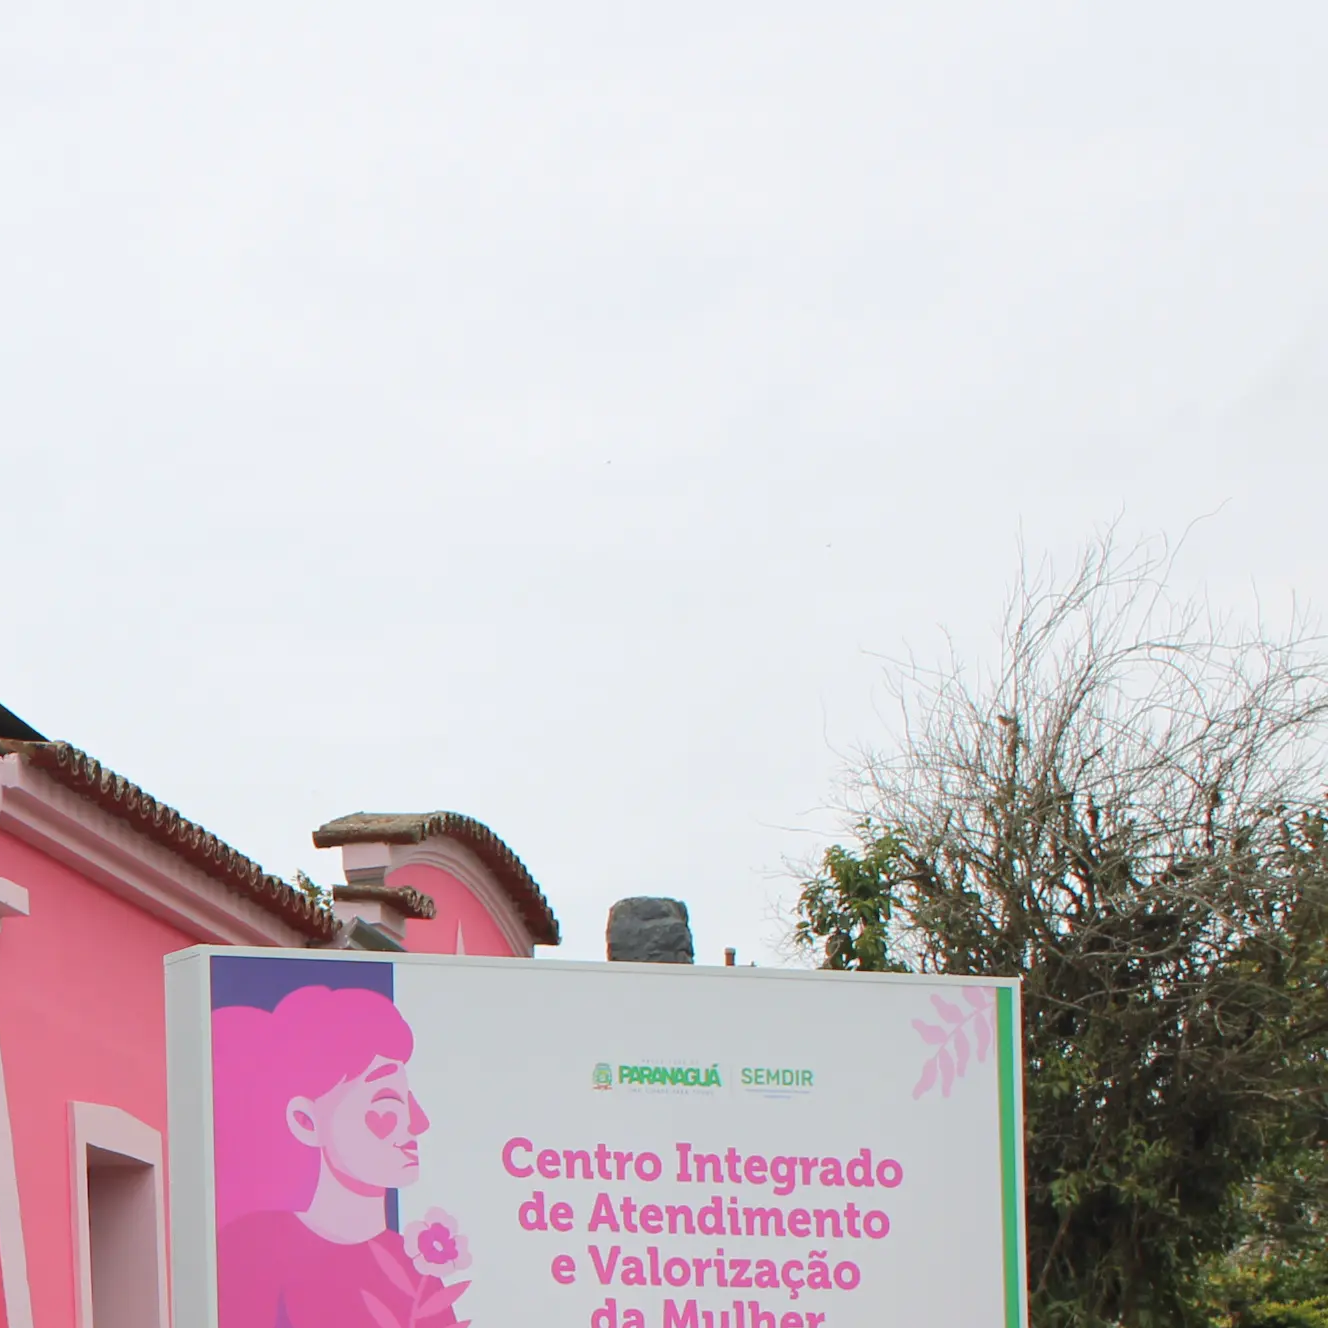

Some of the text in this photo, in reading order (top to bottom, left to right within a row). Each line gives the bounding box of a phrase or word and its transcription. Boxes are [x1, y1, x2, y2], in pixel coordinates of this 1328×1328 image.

[618, 1063, 722, 1087] PARANAGUÁ
[741, 1068, 814, 1087] SEMDIR
[501, 1136, 904, 1196] Centro Integrado
[518, 1190, 891, 1240] de Atendimento
[550, 1244, 862, 1300] e Valorização
